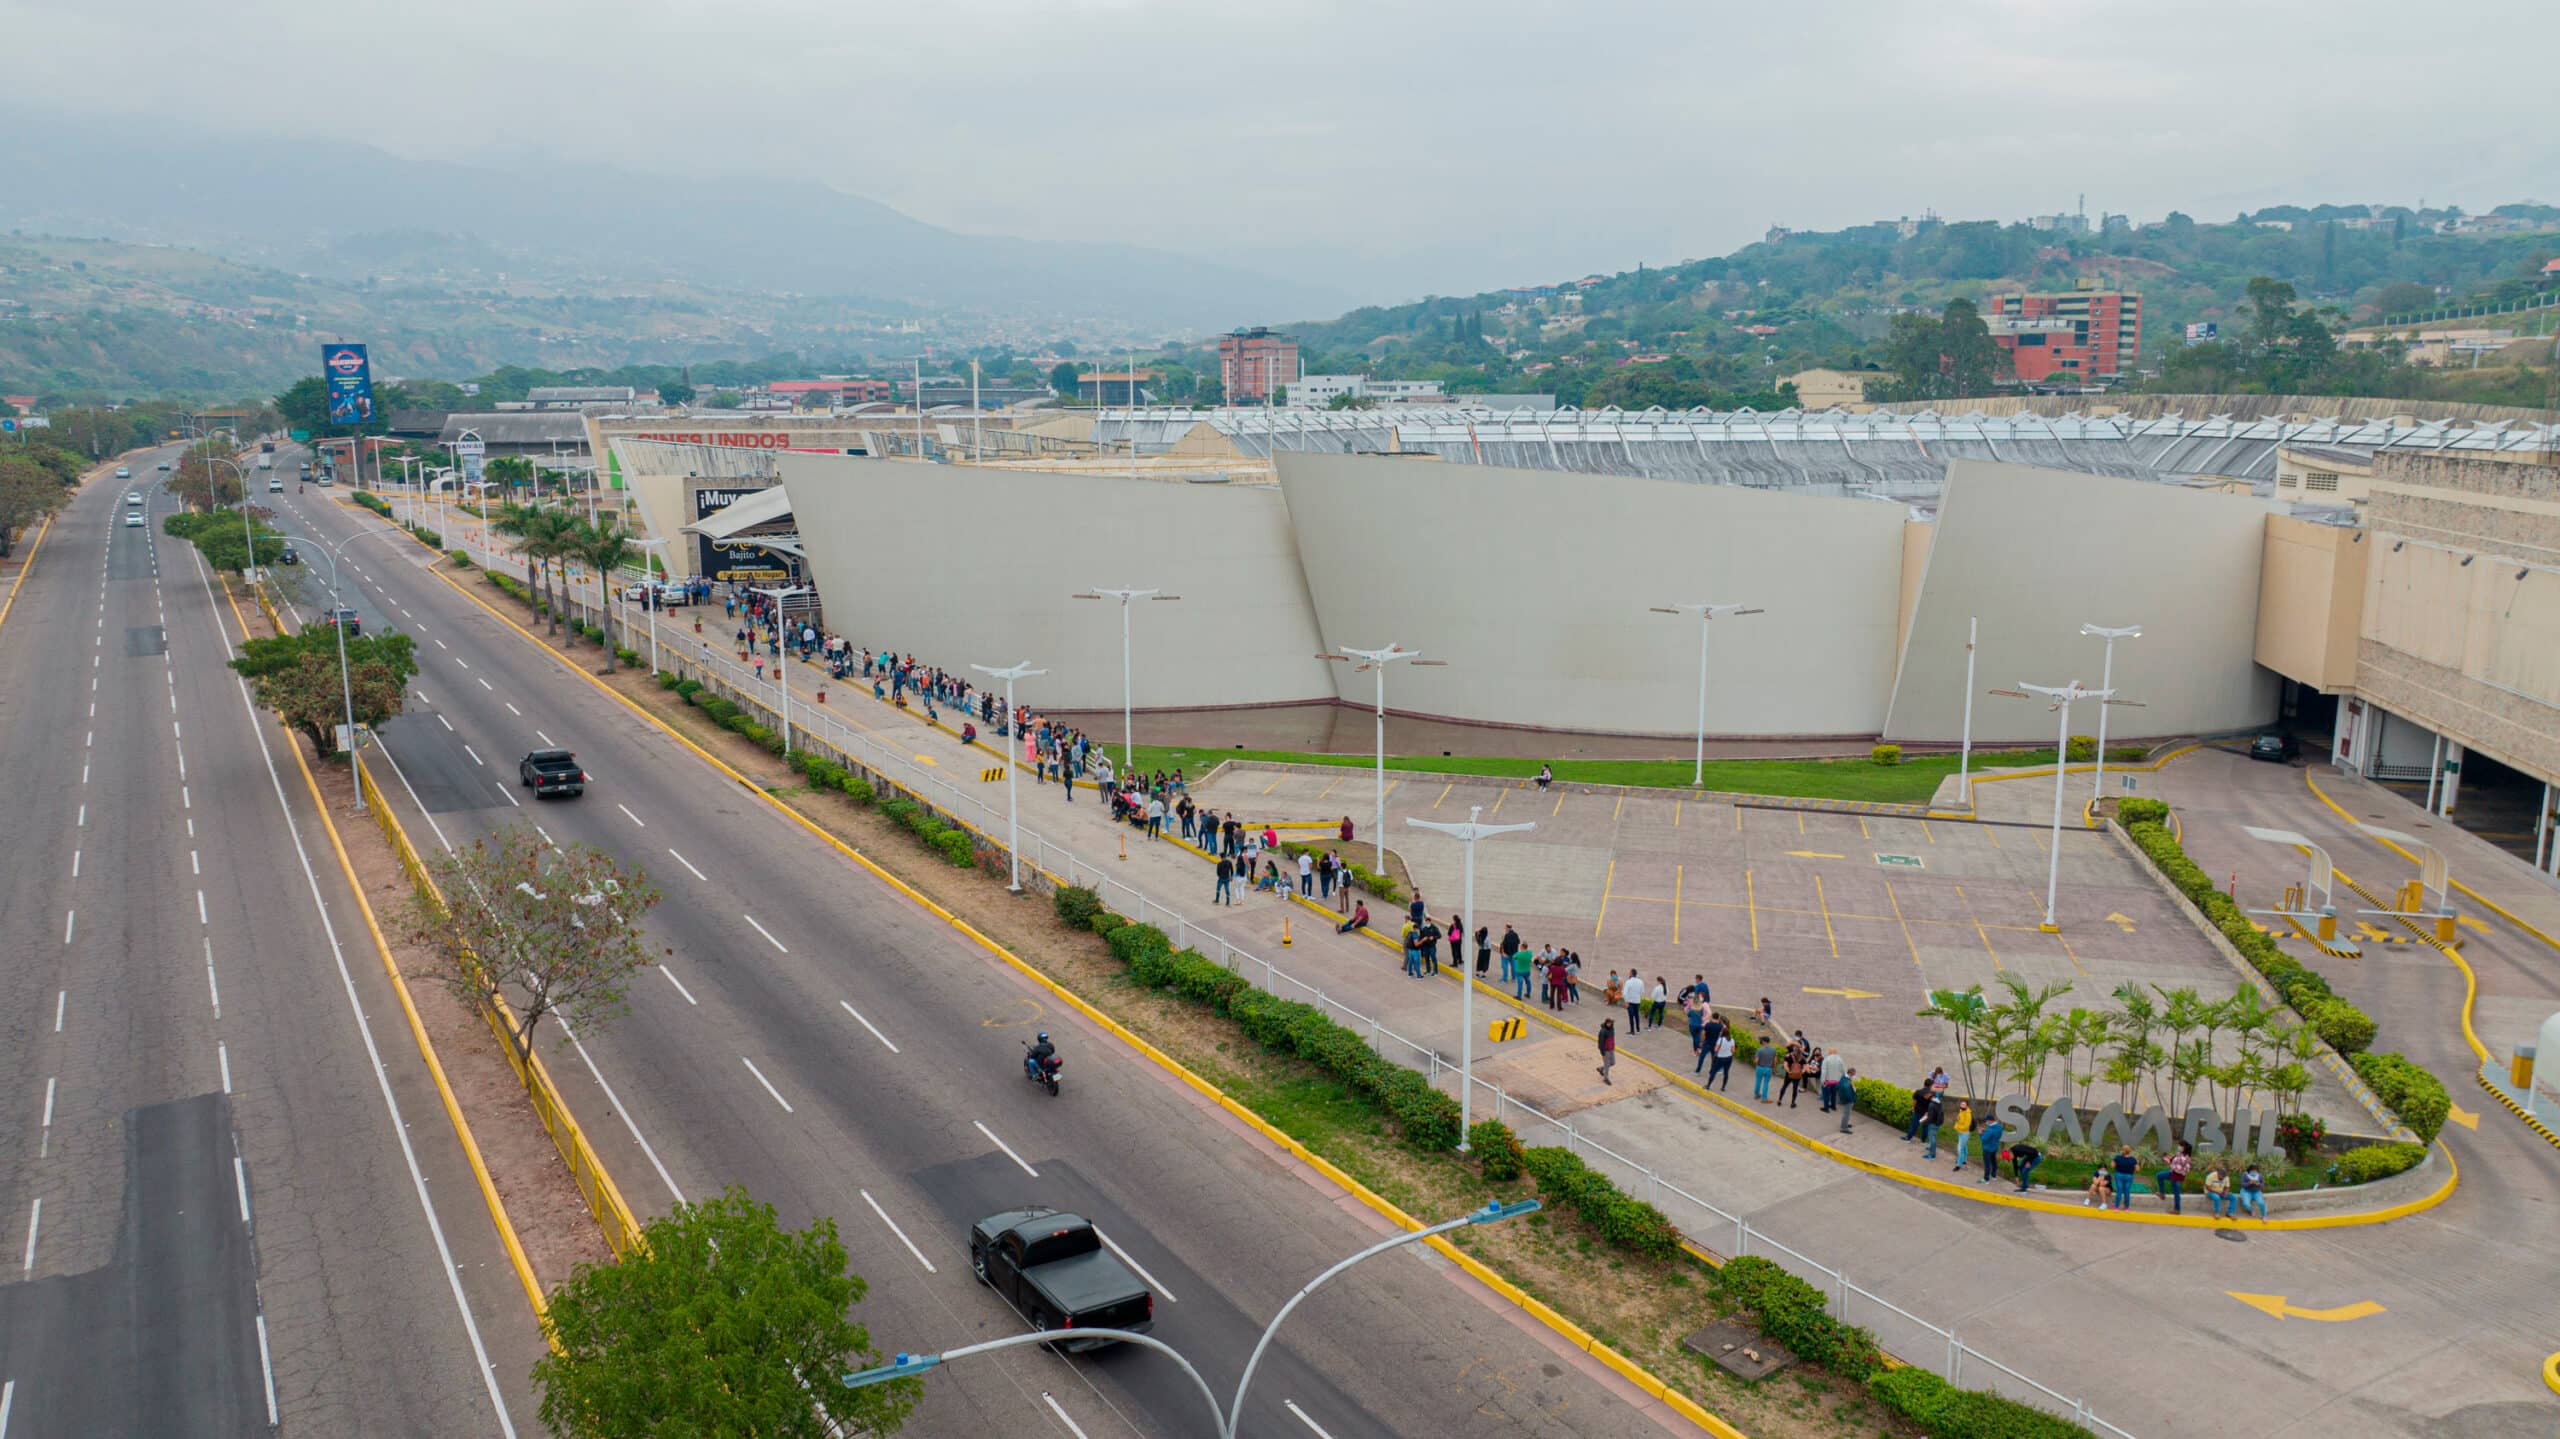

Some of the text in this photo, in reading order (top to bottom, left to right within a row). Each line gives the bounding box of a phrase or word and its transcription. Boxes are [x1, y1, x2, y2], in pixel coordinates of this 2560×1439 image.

[708, 433, 790, 449] UNIDOS
[729, 550, 756, 562] Bajito
[1995, 1093, 2287, 1158] SAMBIL
